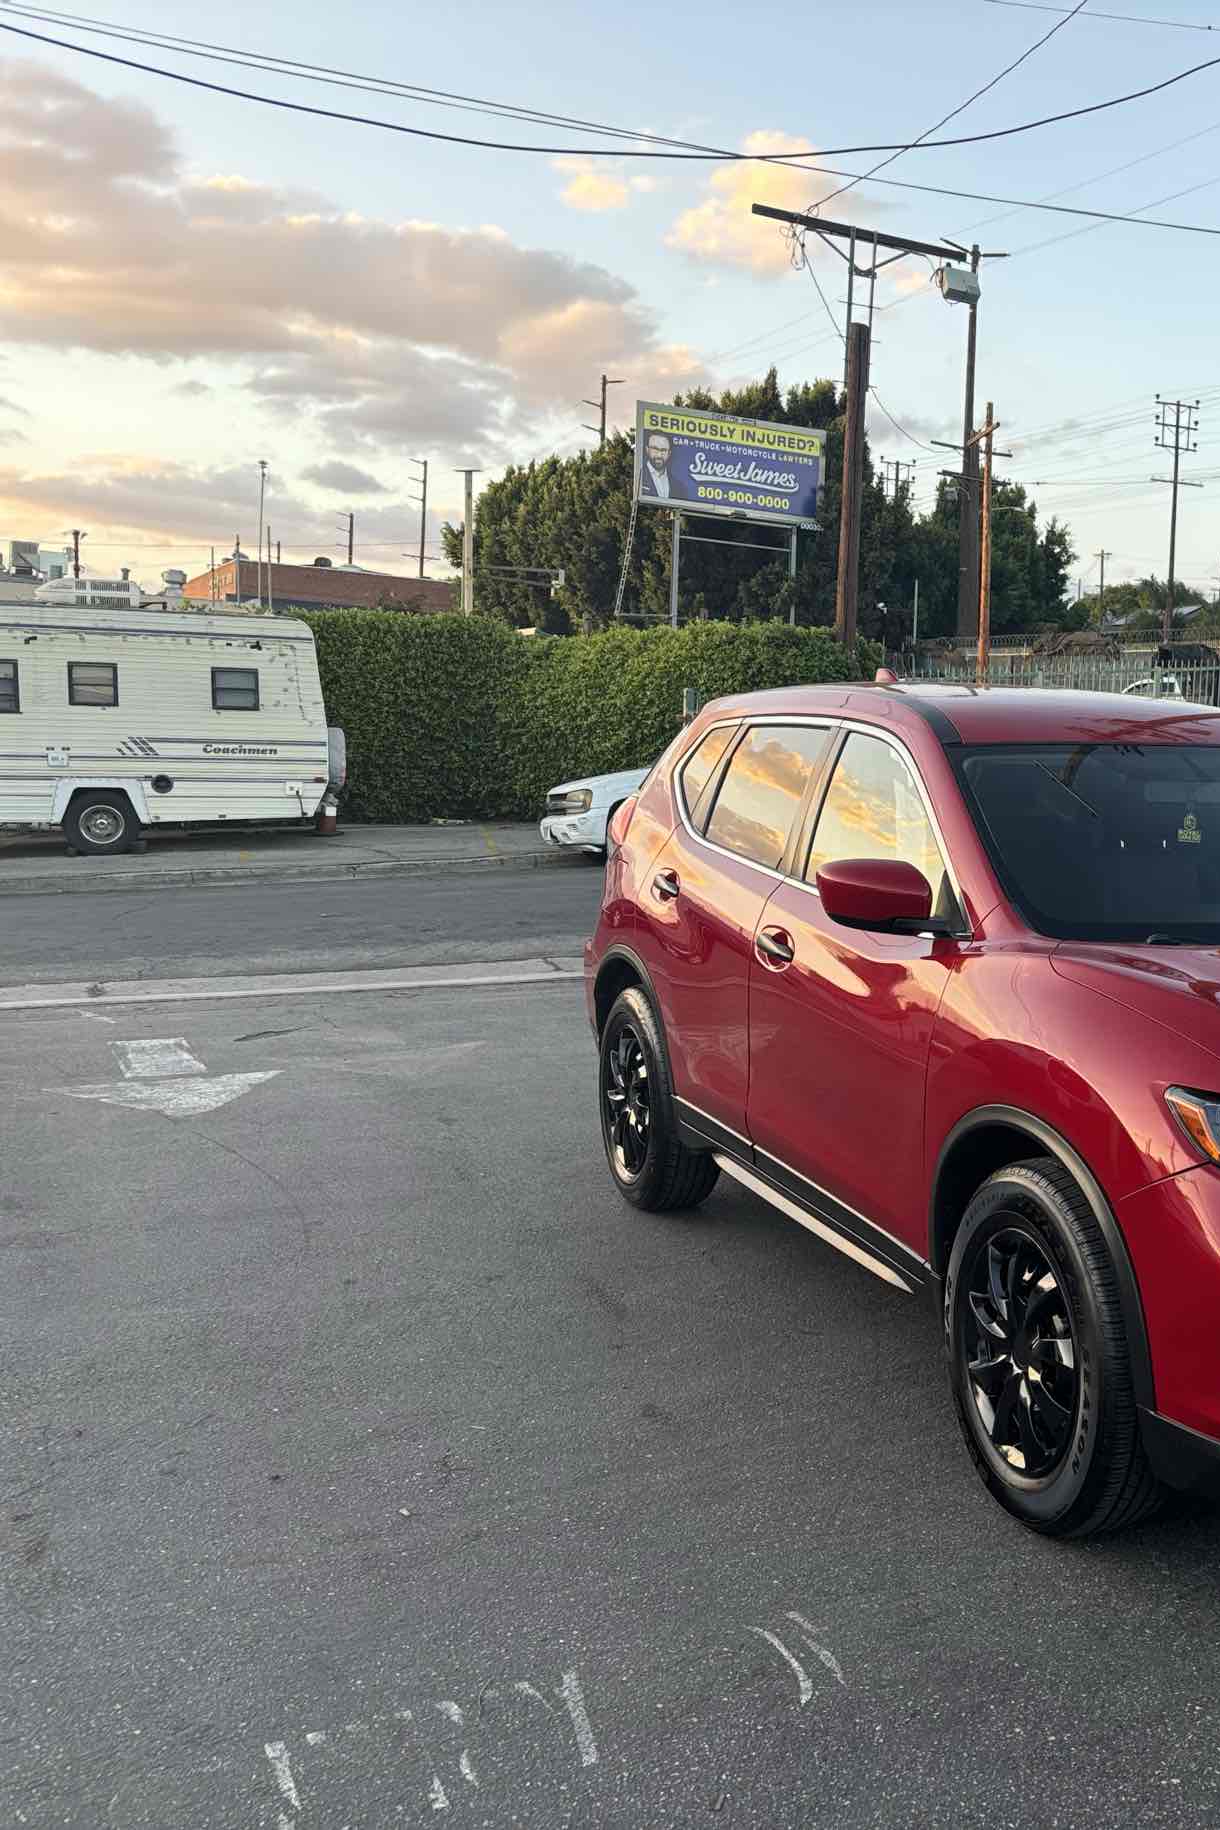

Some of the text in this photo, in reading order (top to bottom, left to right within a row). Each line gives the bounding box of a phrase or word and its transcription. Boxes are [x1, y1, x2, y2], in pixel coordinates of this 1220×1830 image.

[649, 413, 736, 438] SERIOUSLY
[740, 428, 815, 452] INJURED?
[673, 437, 813, 466] CAR TRUCK MOTORCYCLE LAWYERS
[689, 451, 797, 488] Sweet James
[697, 486, 791, 510] 800-900-0000
[202, 743, 278, 756] Coachmen
